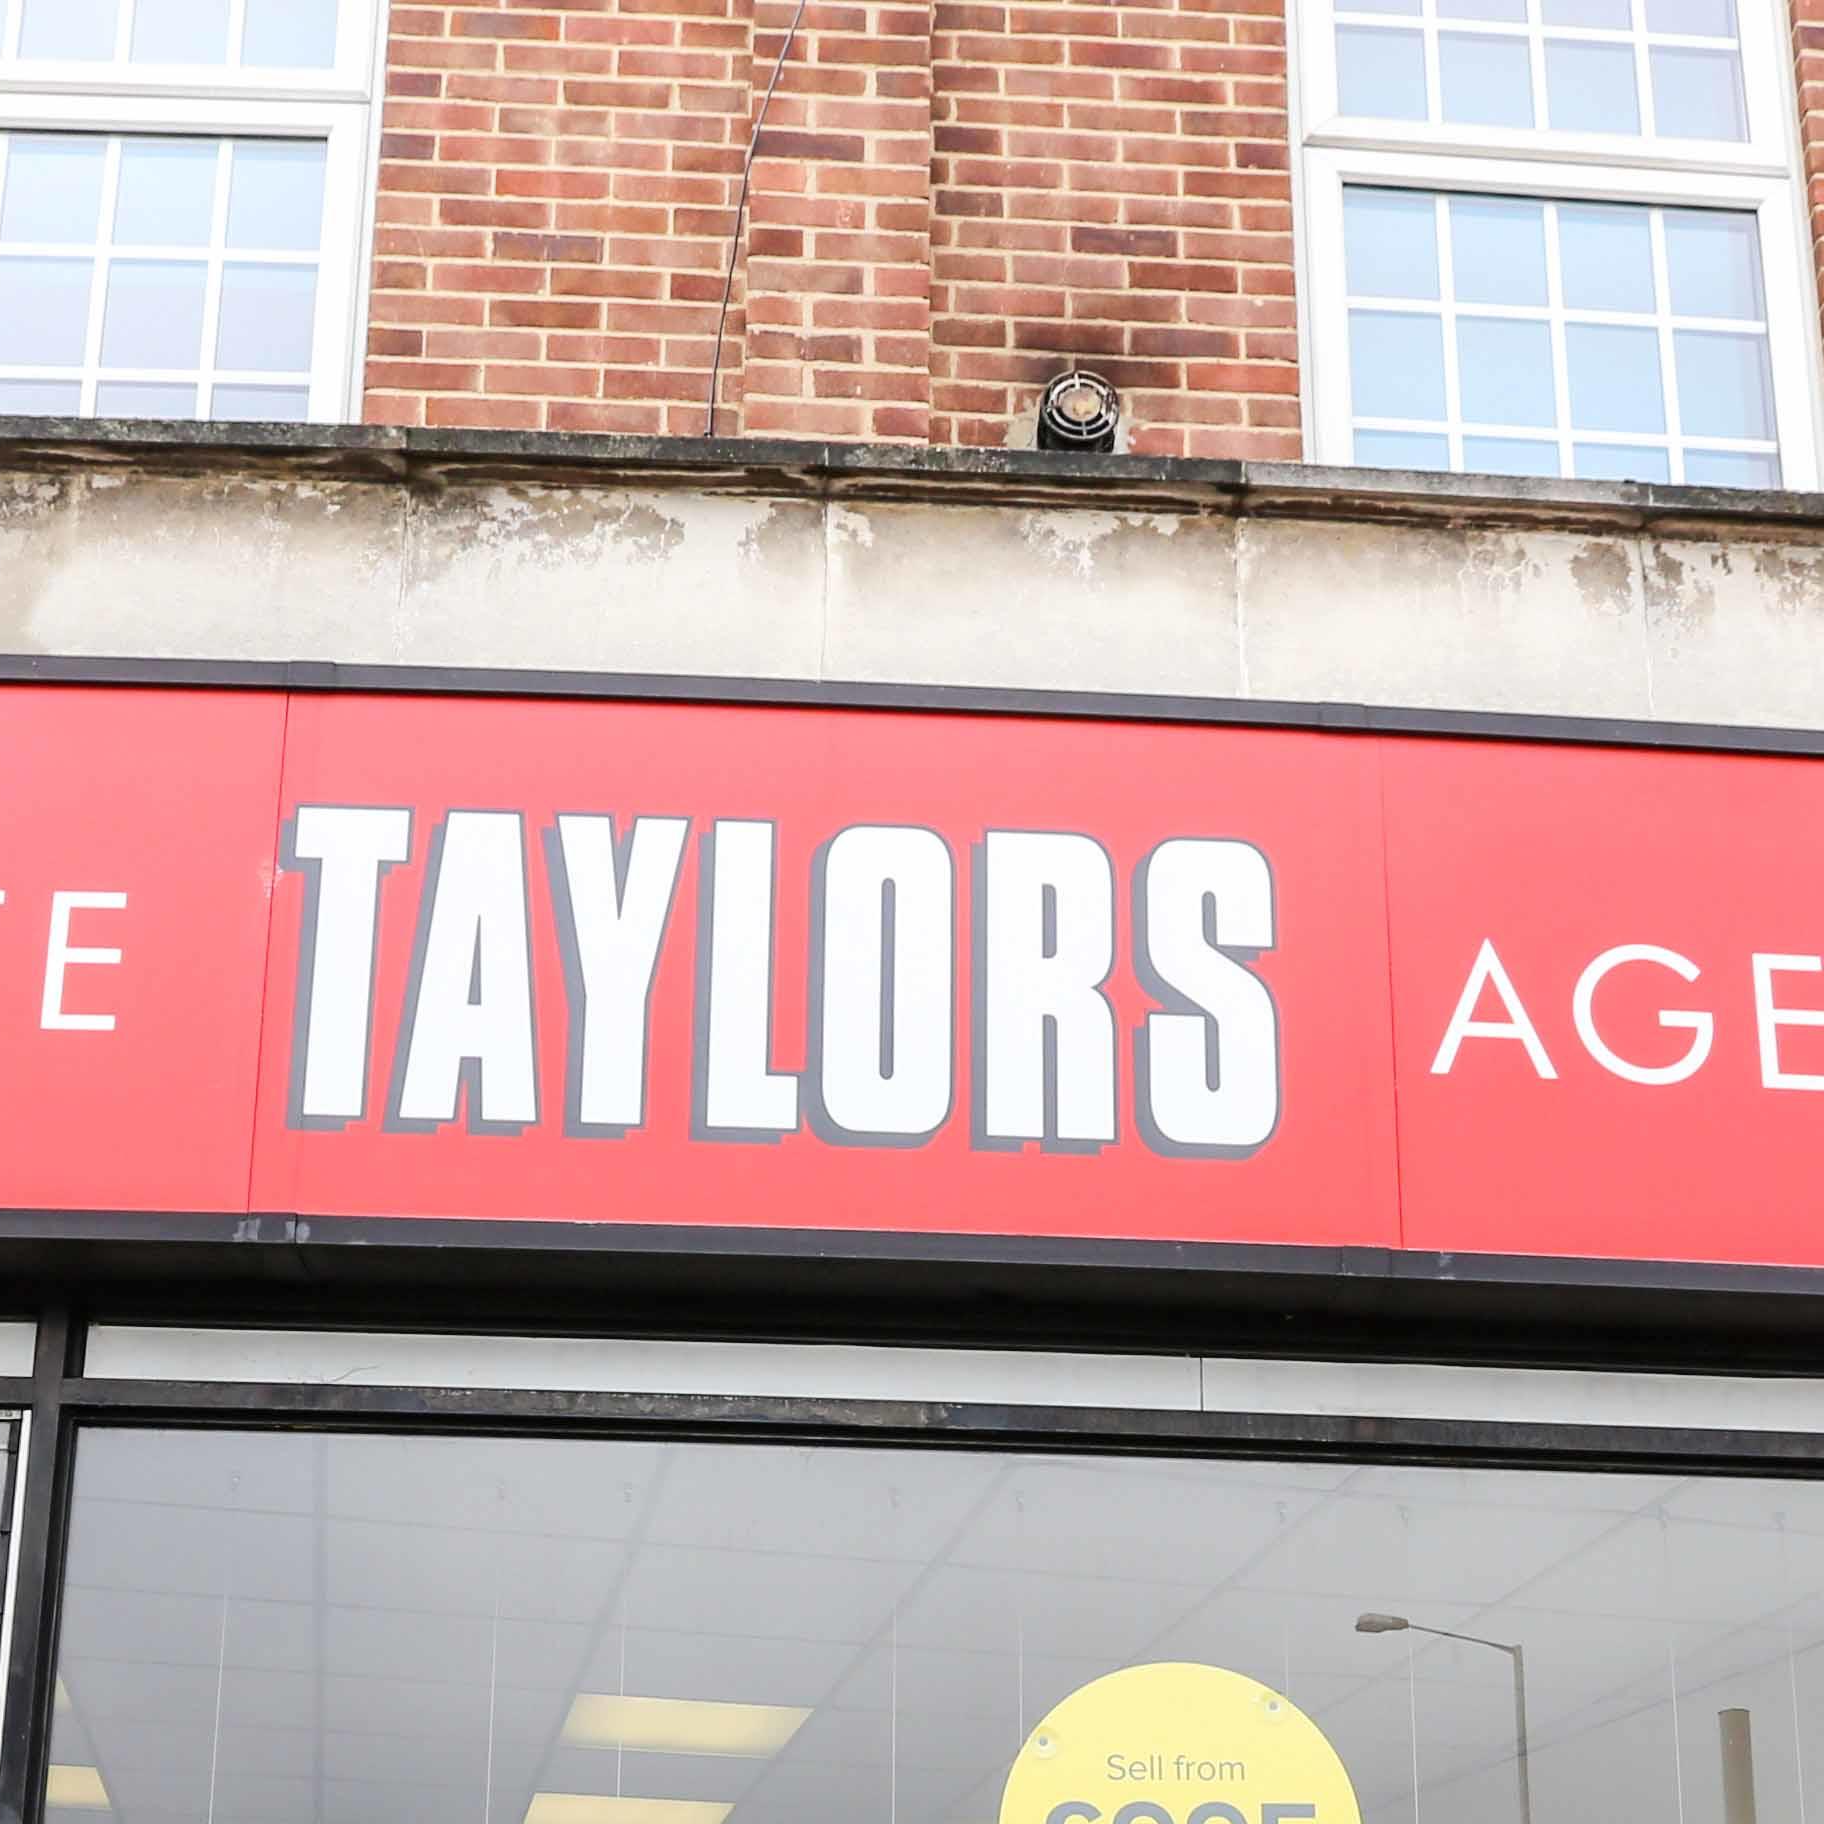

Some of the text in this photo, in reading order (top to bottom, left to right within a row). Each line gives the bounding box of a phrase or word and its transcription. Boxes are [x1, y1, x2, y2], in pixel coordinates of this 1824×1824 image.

[283, 804, 1280, 1157] TAYLORS
[1106, 1754, 1246, 1782] Sell from
